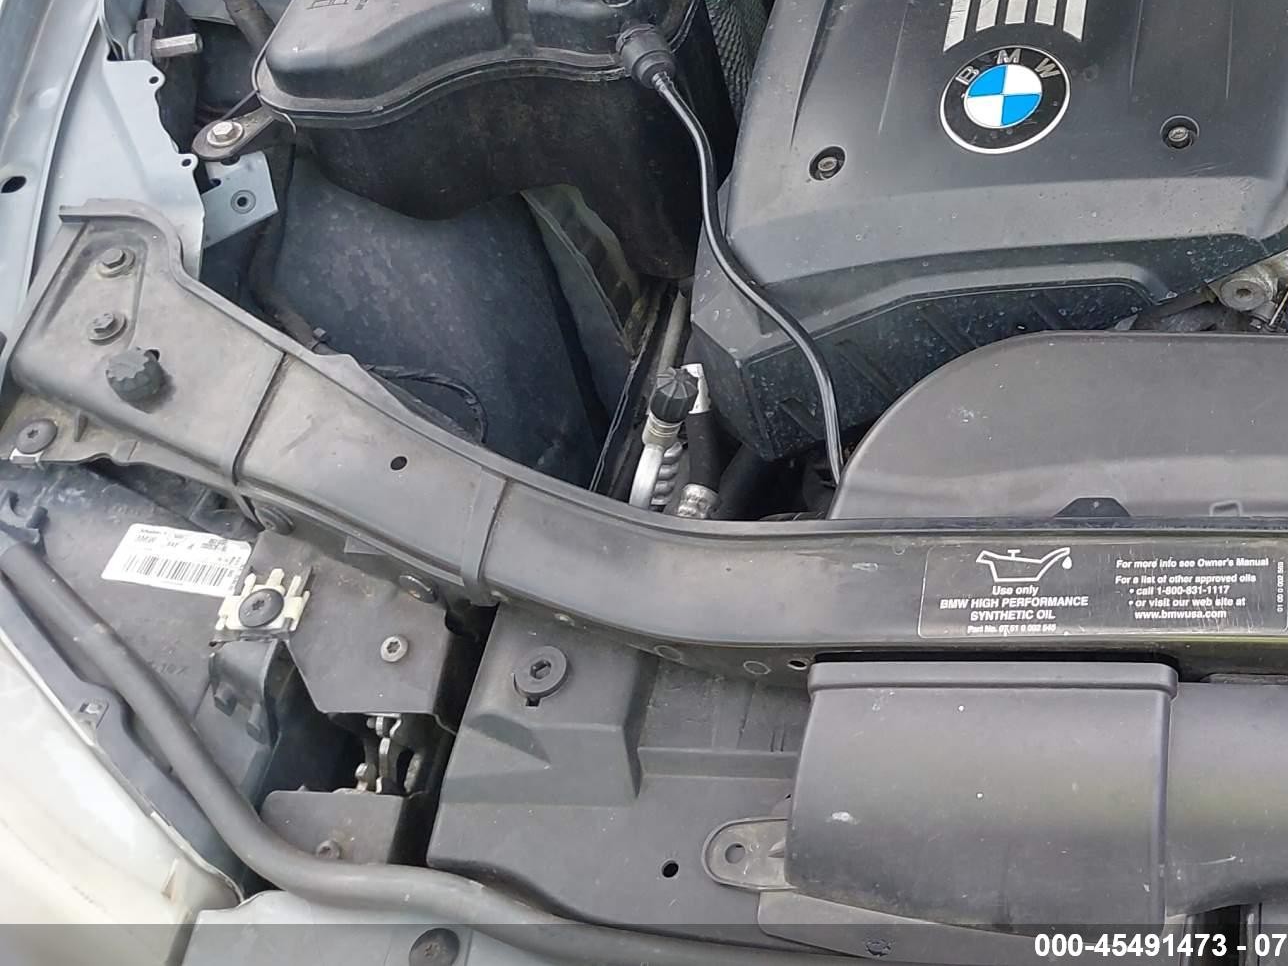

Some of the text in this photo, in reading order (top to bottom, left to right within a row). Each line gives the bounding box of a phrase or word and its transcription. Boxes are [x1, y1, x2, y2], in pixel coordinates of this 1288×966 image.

[955, 48, 1061, 85] BMW
[1116, 557, 1269, 568] For more info see Owner's Manual
[1115, 573, 1257, 585] For a list of other approved oils
[992, 585, 1039, 597] Use only
[1136, 585, 1230, 595] call 1-800-831-1117
[940, 596, 1089, 609] BMW HIGH PERFORMANCE
[1135, 597, 1246, 607] or visit our web site at
[970, 609, 1056, 621] SYNTHETIC OIL
[1134, 610, 1227, 619] www.bmwusa.com
